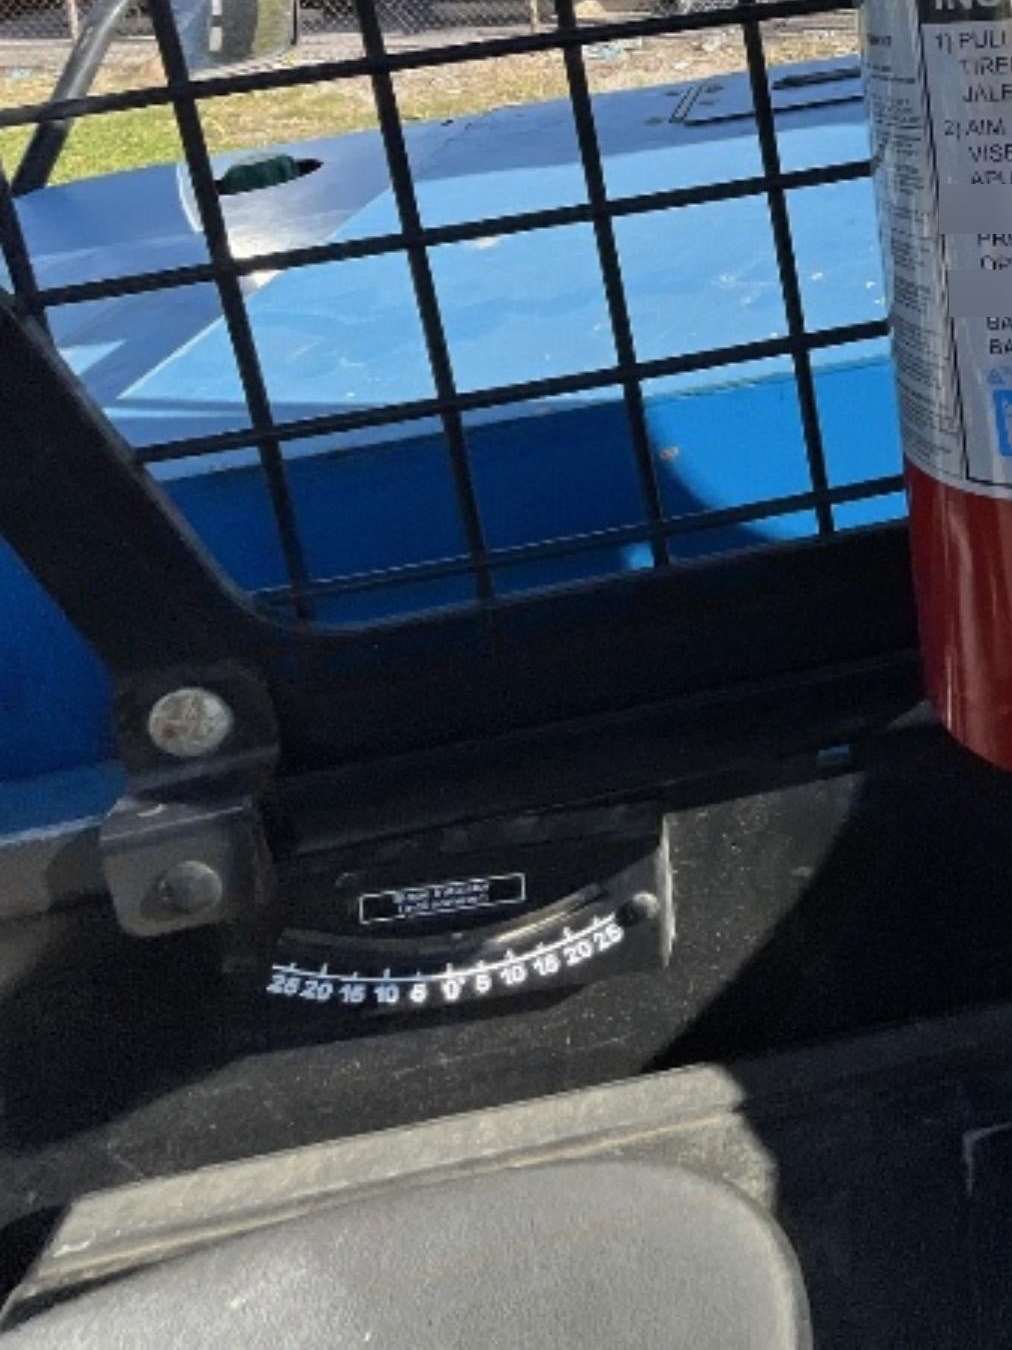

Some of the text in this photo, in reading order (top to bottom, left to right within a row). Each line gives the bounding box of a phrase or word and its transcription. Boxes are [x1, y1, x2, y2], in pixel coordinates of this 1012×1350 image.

[965, 119, 1007, 137] AIM
[300, 979, 334, 1003] 20
[374, 983, 400, 1004] 10
[472, 973, 492, 994] 5
[501, 963, 527, 986] 10
[564, 939, 594, 967] 20
